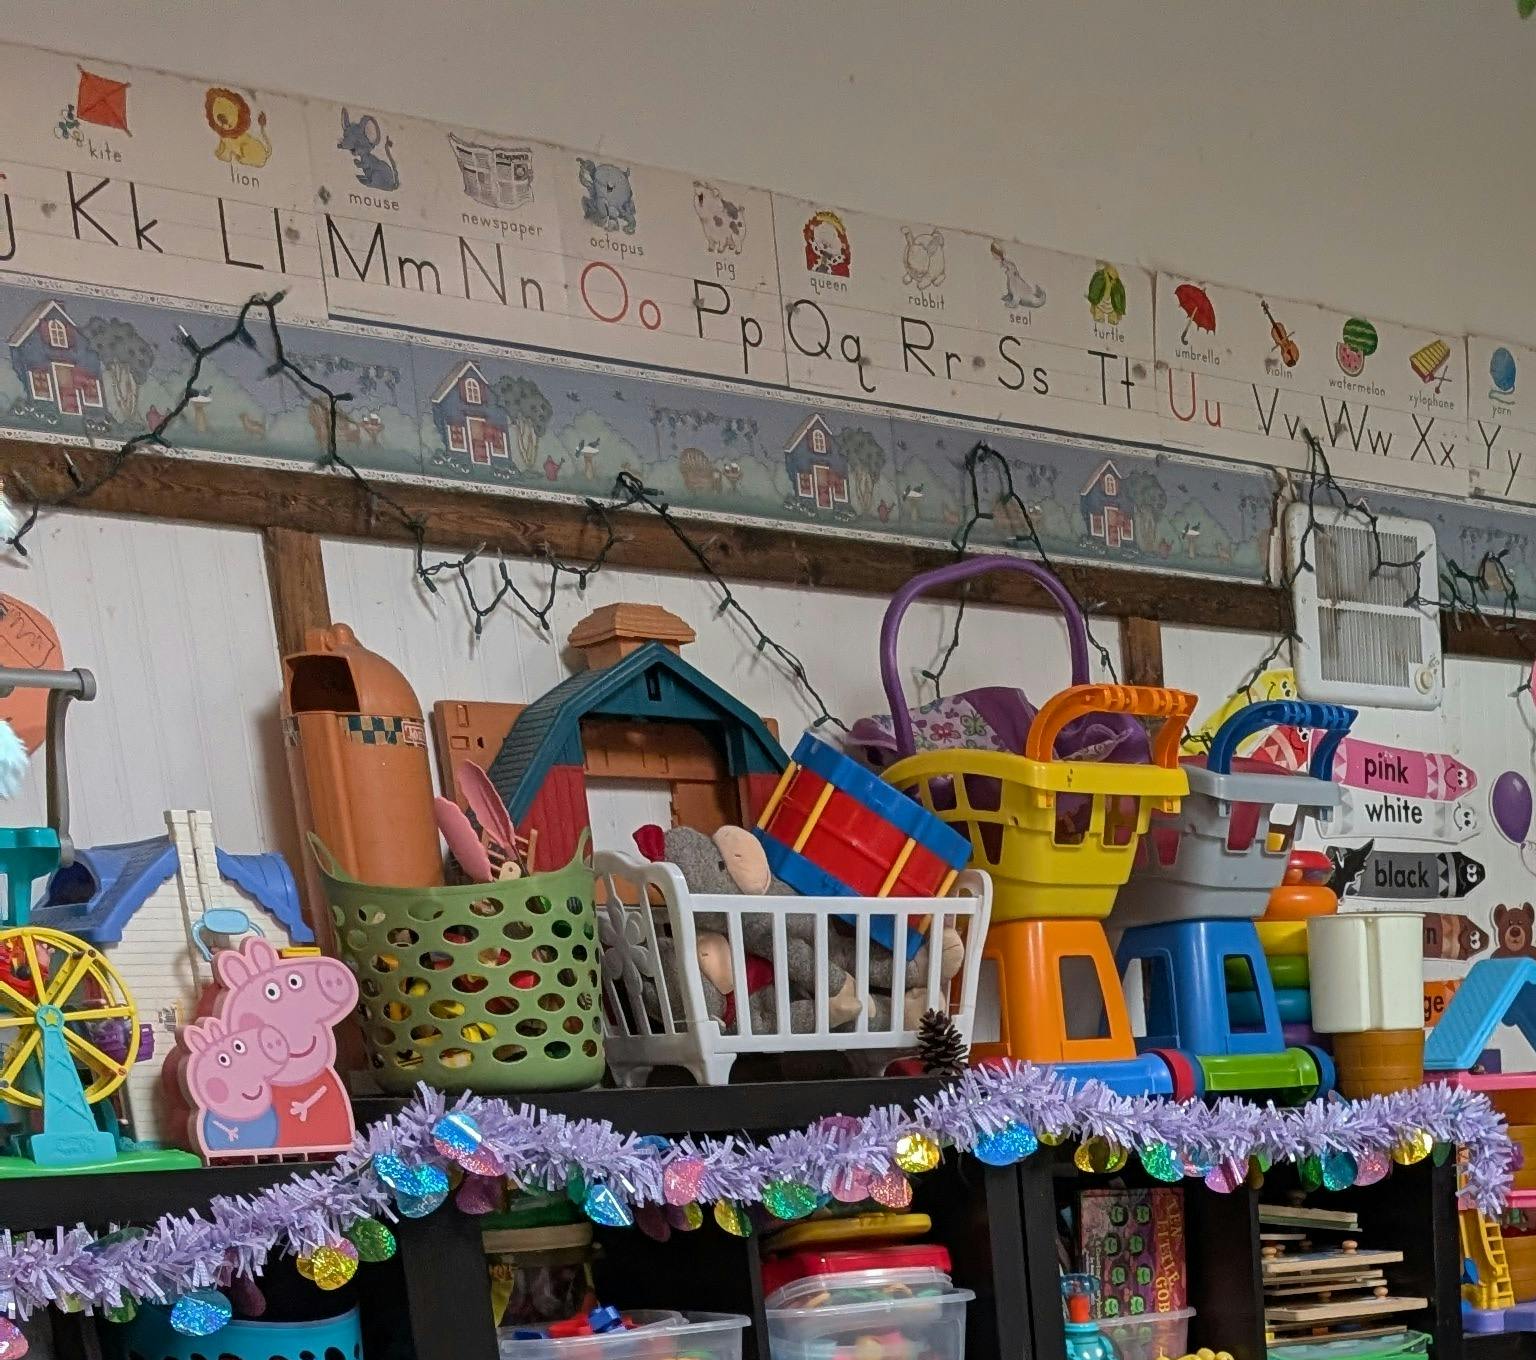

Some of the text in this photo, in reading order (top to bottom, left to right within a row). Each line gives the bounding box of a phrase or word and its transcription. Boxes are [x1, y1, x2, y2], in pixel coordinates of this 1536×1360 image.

[88, 139, 122, 163] kite
[229, 163, 260, 187] lion
[349, 192, 400, 212] mouse
[461, 211, 544, 241] newspaper
[590, 233, 644, 260] octopus
[715, 259, 736, 281] pig
[809, 277, 849, 296] queen
[907, 292, 946, 311] rabbit
[1008, 310, 1033, 327] seal
[1093, 325, 1125, 344] turtle
[1174, 347, 1221, 367] umbrella
[1264, 364, 1294, 380] violin
[1328, 376, 1386, 397] watermelon
[1491, 405, 1512, 419] yarn
[1364, 753, 1410, 785] pink
[1365, 794, 1424, 825] white
[1374, 859, 1430, 889] black
